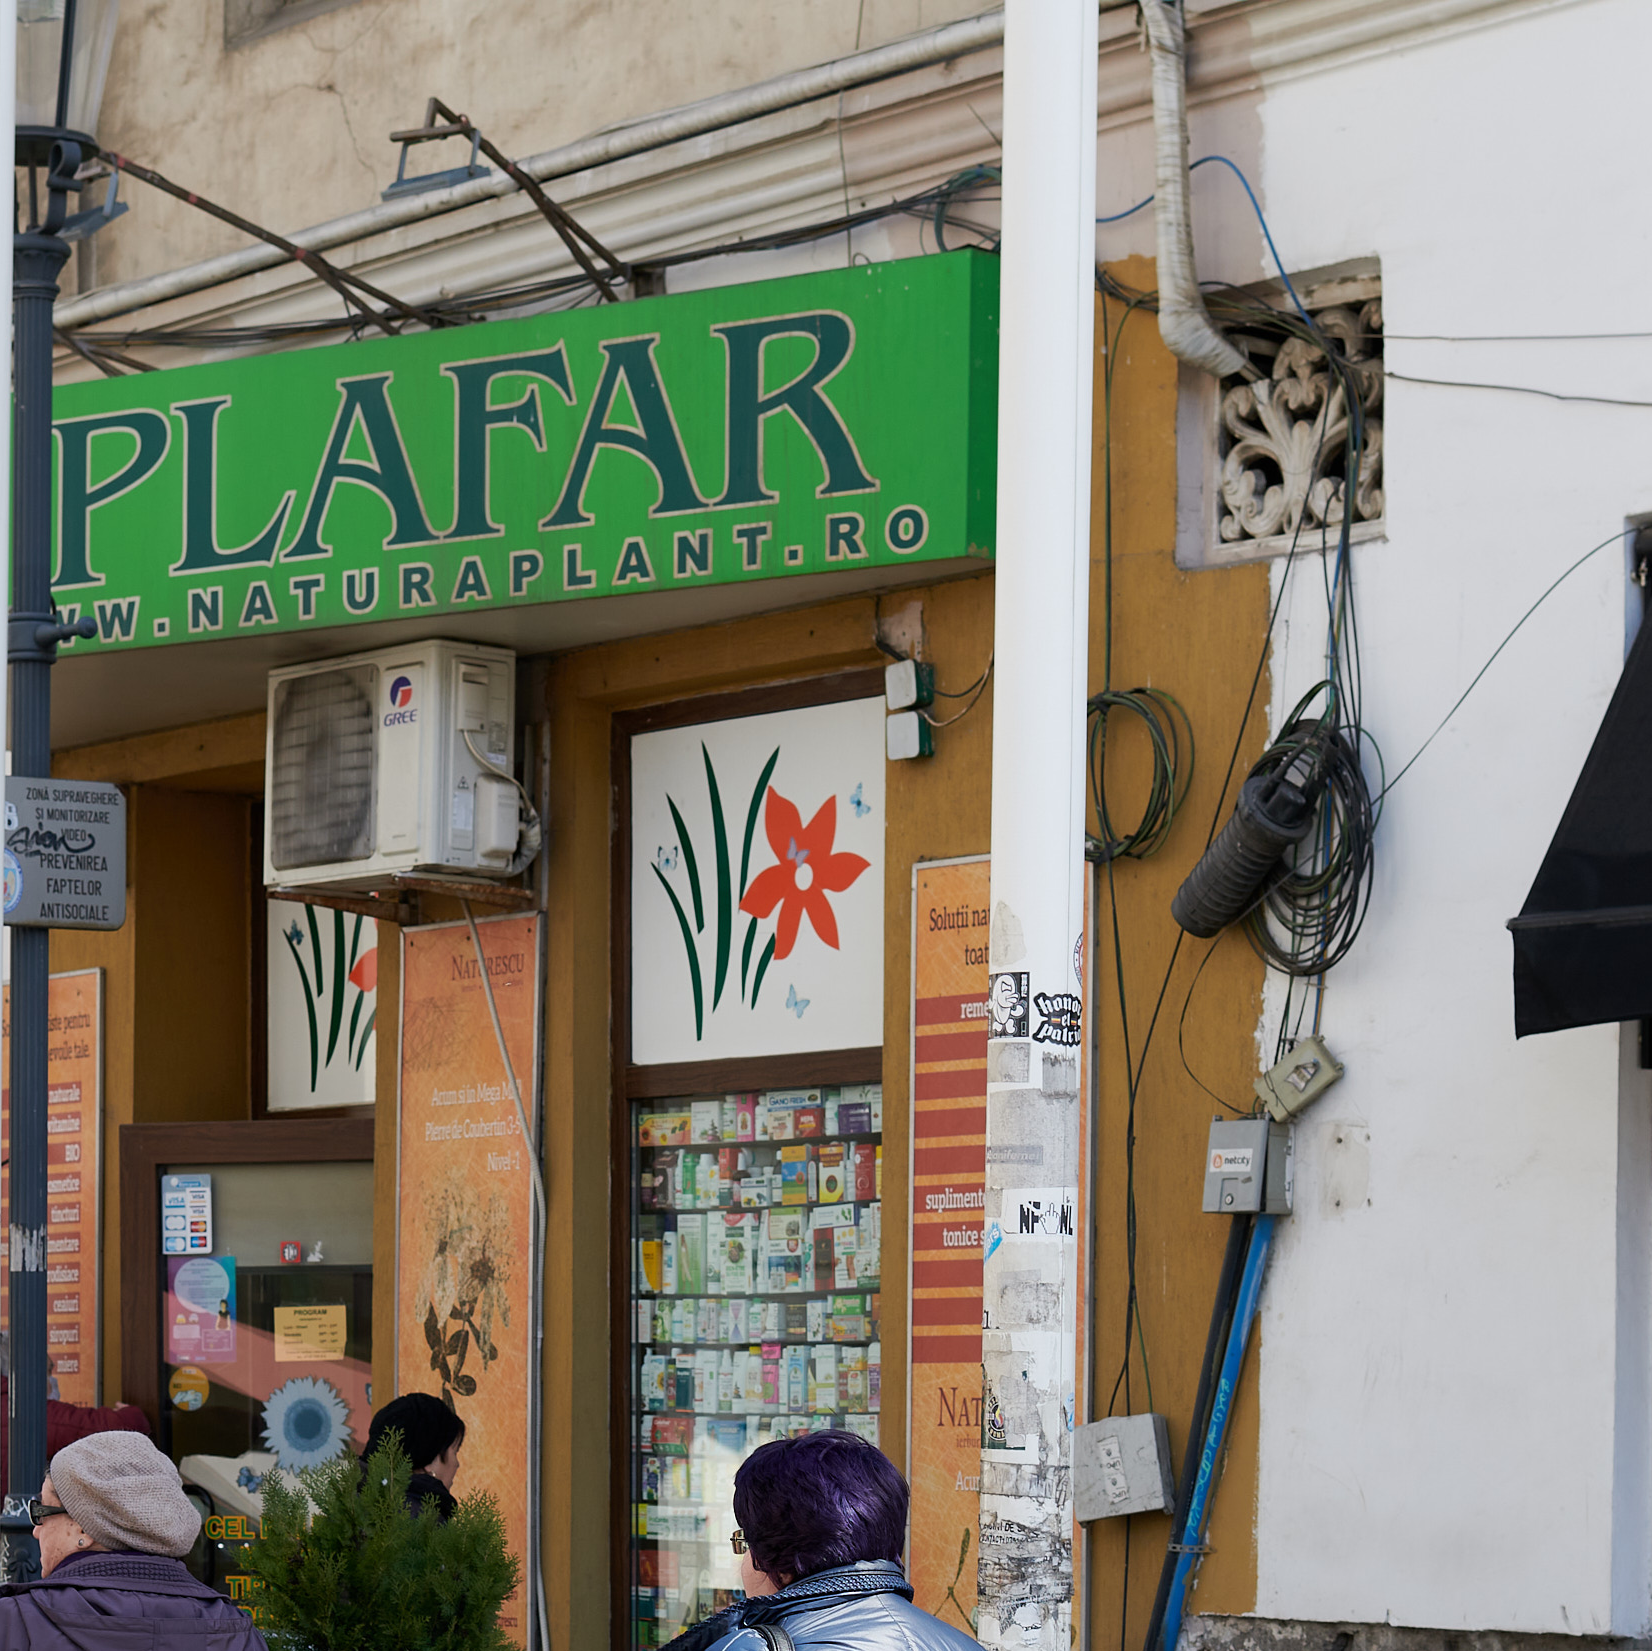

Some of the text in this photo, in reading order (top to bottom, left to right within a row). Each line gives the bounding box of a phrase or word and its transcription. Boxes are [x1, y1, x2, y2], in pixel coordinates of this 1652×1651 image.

[52, 309, 880, 591] PLAFAR
[384, 709, 418, 727] GREE
[52, 789, 119, 806] SUPRAVEGHERE
[46, 809, 110, 824] MONITORIZARE
[61, 828, 86, 842] VIDEO
[40, 853, 108, 871] PREVENIREA
[46, 878, 102, 896] FAPTELOR
[40, 902, 109, 921] ANTISOCIALE
[965, 943, 989, 966] toat
[960, 1002, 989, 1019] reme
[431, 1087, 457, 1107] Acum
[477, 1082, 501, 1106] Mega
[425, 1121, 451, 1141] Pierre
[463, 1117, 506, 1139] Coubertin
[65, 1144, 80, 1162] BIO
[487, 1152, 511, 1172] Nivel
[47, 1174, 80, 1193] osmetice
[943, 1225, 979, 1247] tonice
[56, 1356, 79, 1373] miere
[205, 1515, 256, 1540] CEL
